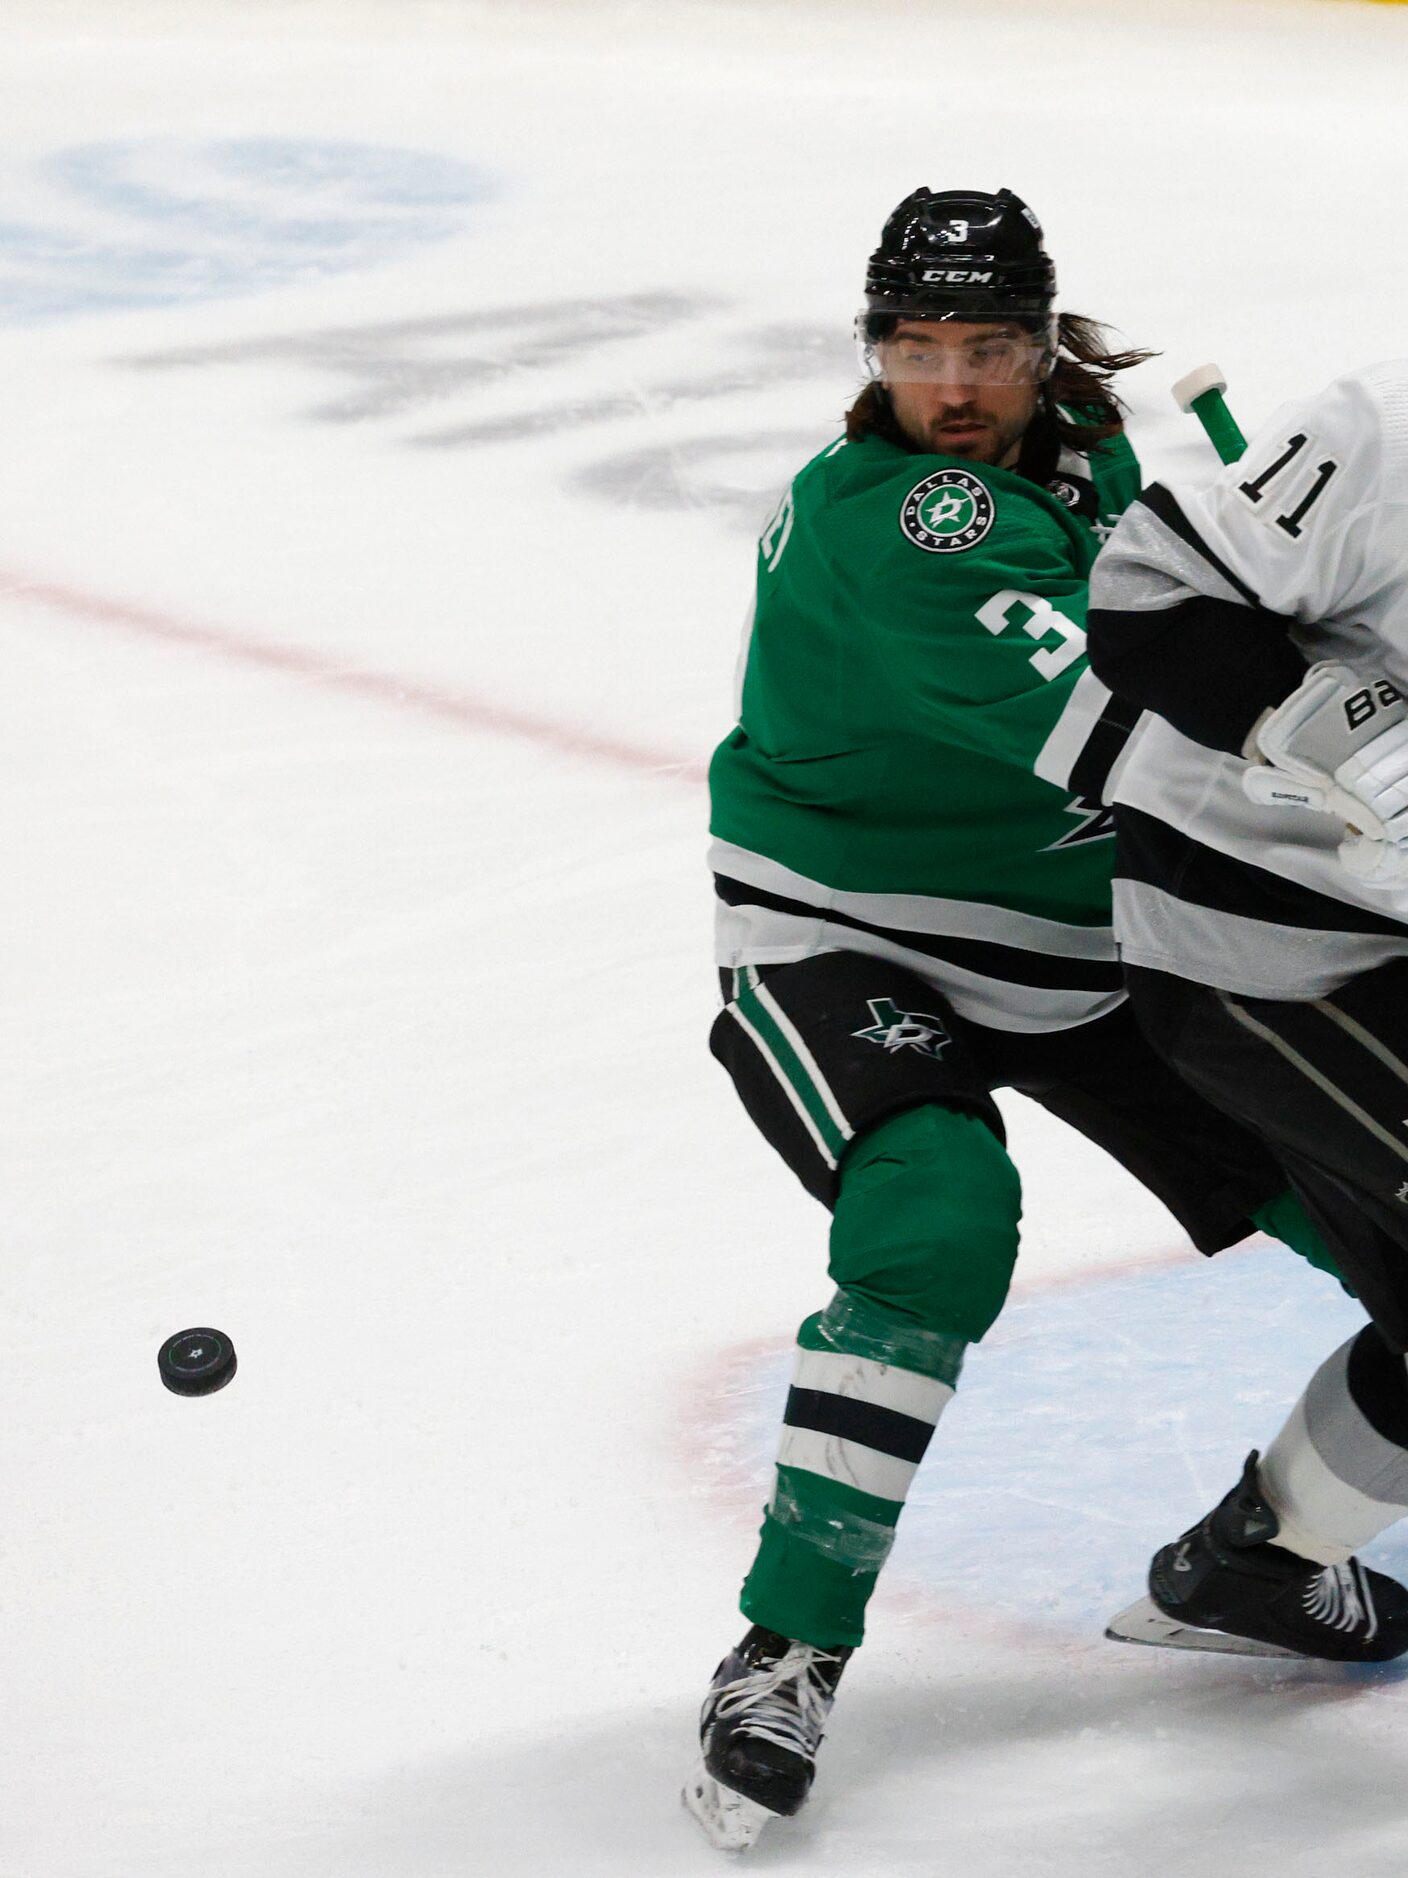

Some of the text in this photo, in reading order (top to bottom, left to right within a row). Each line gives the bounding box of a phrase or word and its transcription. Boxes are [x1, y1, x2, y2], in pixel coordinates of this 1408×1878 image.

[948, 219, 969, 243] 3
[922, 270, 993, 284] CCM
[905, 475, 984, 516] DALLAS
[1238, 432, 1338, 539] 11
[915, 516, 987, 546] STARS
[974, 589, 1088, 682] 3
